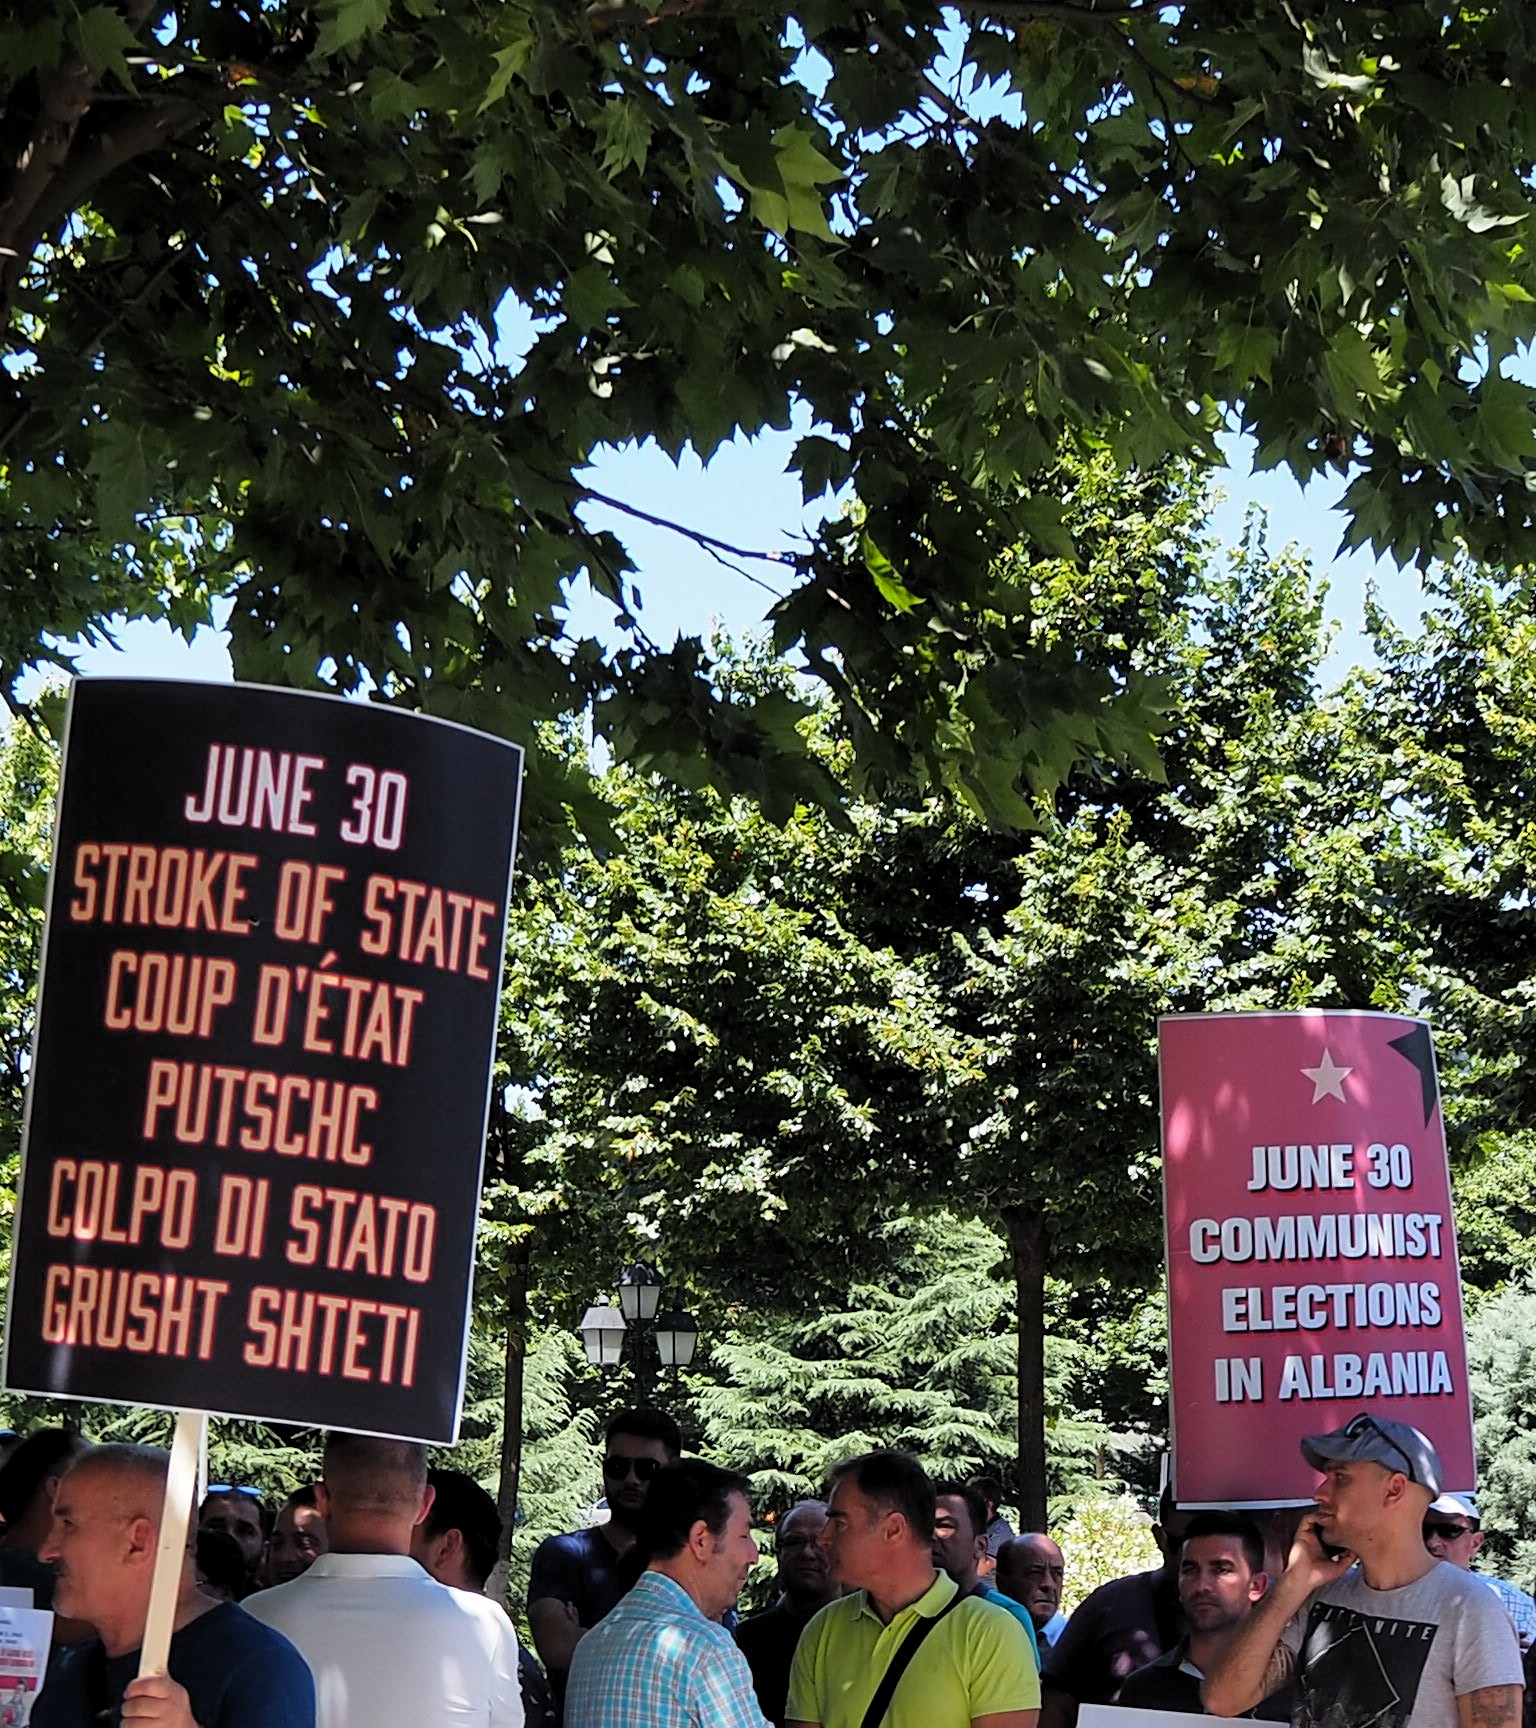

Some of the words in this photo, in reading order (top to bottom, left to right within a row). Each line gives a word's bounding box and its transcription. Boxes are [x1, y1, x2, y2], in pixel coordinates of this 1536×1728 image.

[184, 743, 325, 838] JUNE
[340, 765, 409, 850] 30
[69, 843, 258, 934] STROKE
[273, 861, 348, 944] OF
[359, 876, 497, 981] STATE
[104, 950, 236, 1038] COUP
[252, 948, 425, 1067] D'ÉTAT
[142, 1060, 379, 1165] PUTSCHC
[1247, 1143, 1355, 1192] JUNE
[1366, 1143, 1412, 1190] 30
[47, 1158, 199, 1250] COLPO
[214, 1174, 269, 1259] DI
[285, 1186, 437, 1284] STATO
[1189, 1213, 1443, 1264] COMMUNIST
[40, 1266, 229, 1360] GRUSHT
[243, 1286, 420, 1388] SHTETI
[1221, 1281, 1442, 1333] ELECTIONS
[1214, 1357, 1264, 1403] IN
[1278, 1350, 1455, 1401] ALBANIA
